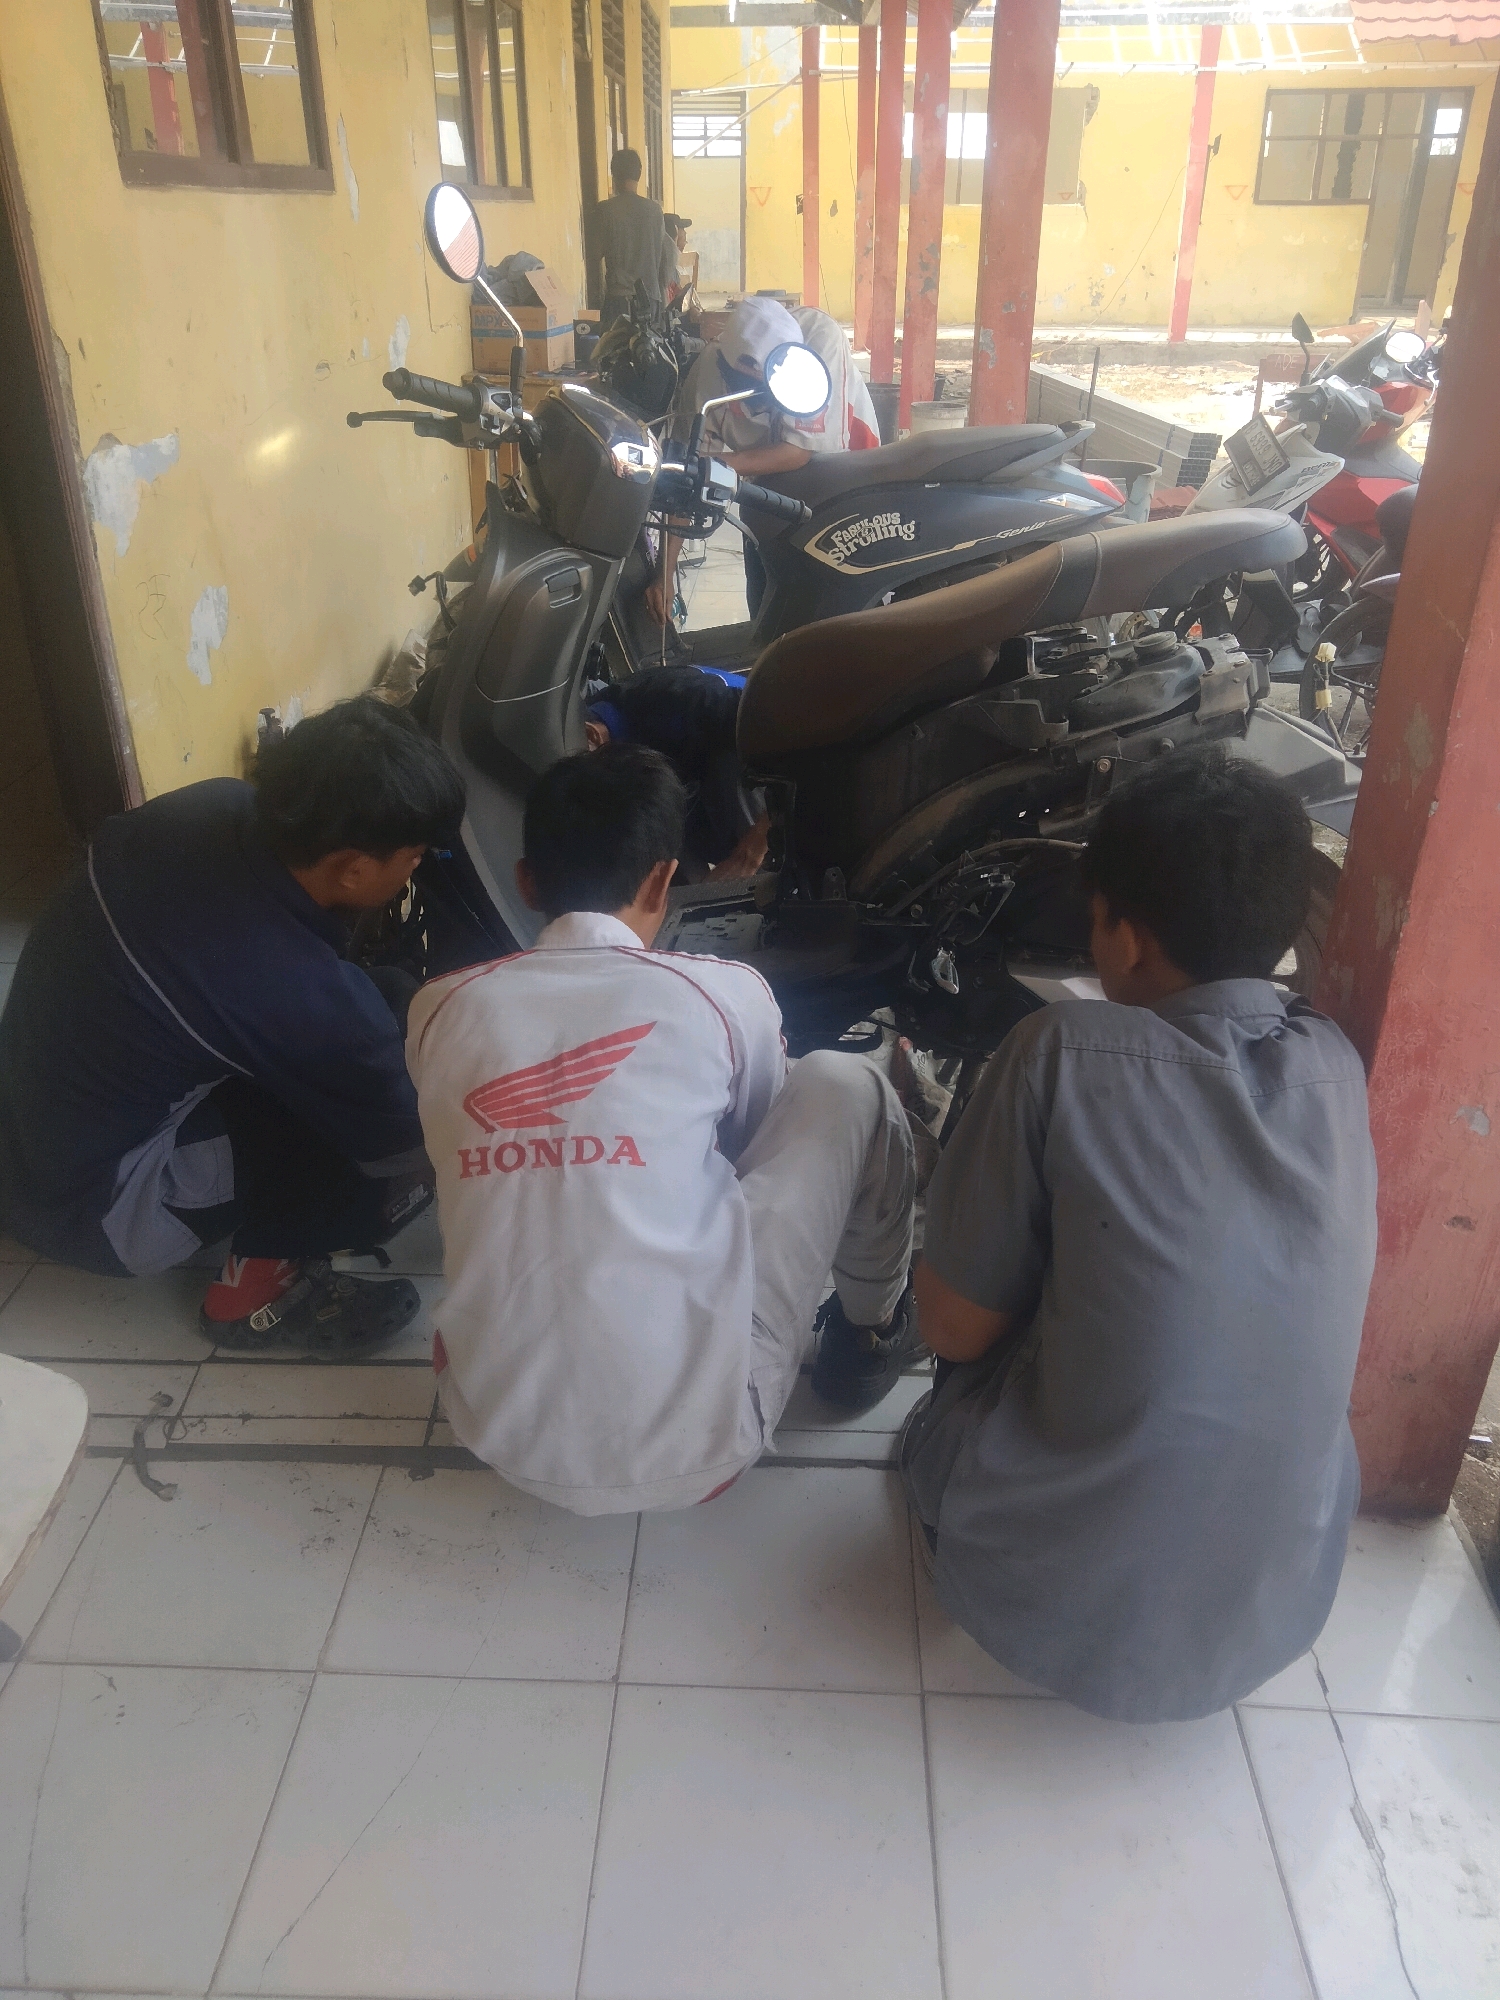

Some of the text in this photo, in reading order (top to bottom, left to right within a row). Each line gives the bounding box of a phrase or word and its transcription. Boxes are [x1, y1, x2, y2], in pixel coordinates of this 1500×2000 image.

[475, 315, 500, 327] MPX
[1275, 353, 1300, 371] ADE
[1245, 422, 1258, 435] B
[1250, 430, 1272, 455] 6999
[996, 521, 1047, 539] Genio
[458, 1135, 646, 1179] HONDA
